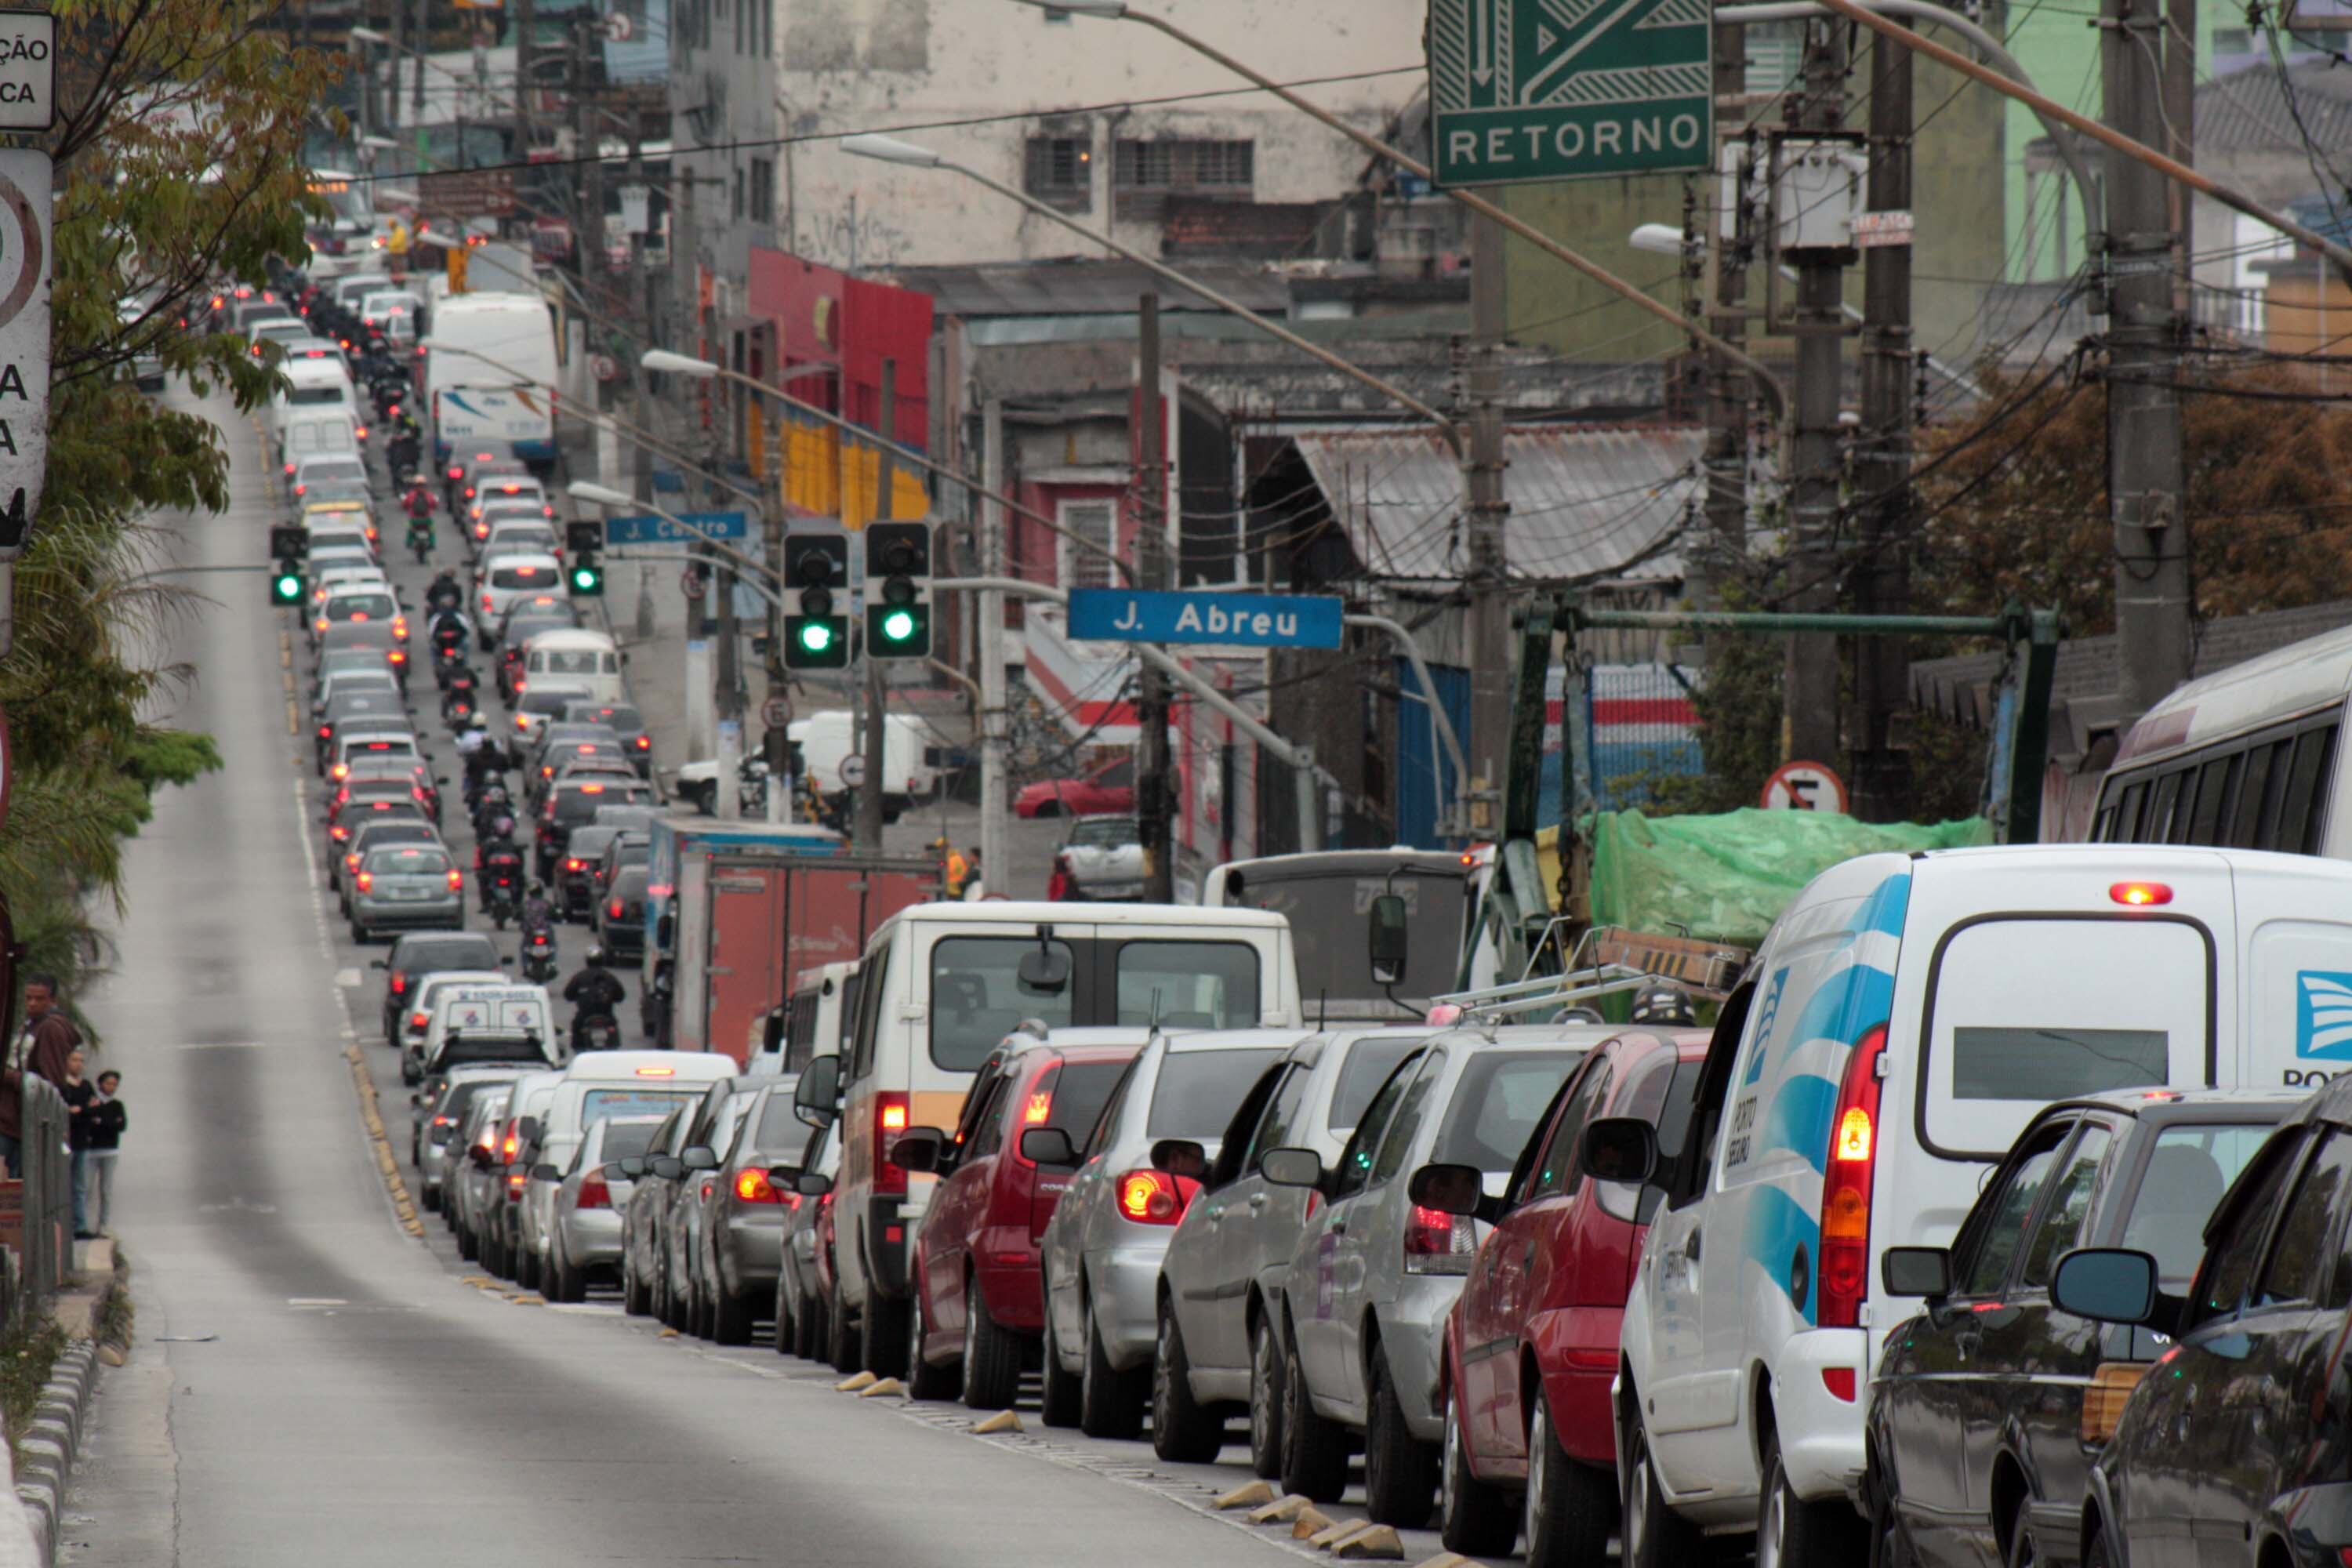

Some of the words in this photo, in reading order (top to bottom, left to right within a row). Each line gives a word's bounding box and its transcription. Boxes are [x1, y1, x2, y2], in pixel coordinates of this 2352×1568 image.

[1450, 114, 1700, 165] RETORNO
[1113, 601, 1143, 630] J.
[1175, 603, 1297, 636] Abreu
[2283, 1069, 2343, 1087] PO
[1733, 1095, 1757, 1134] PORTO
